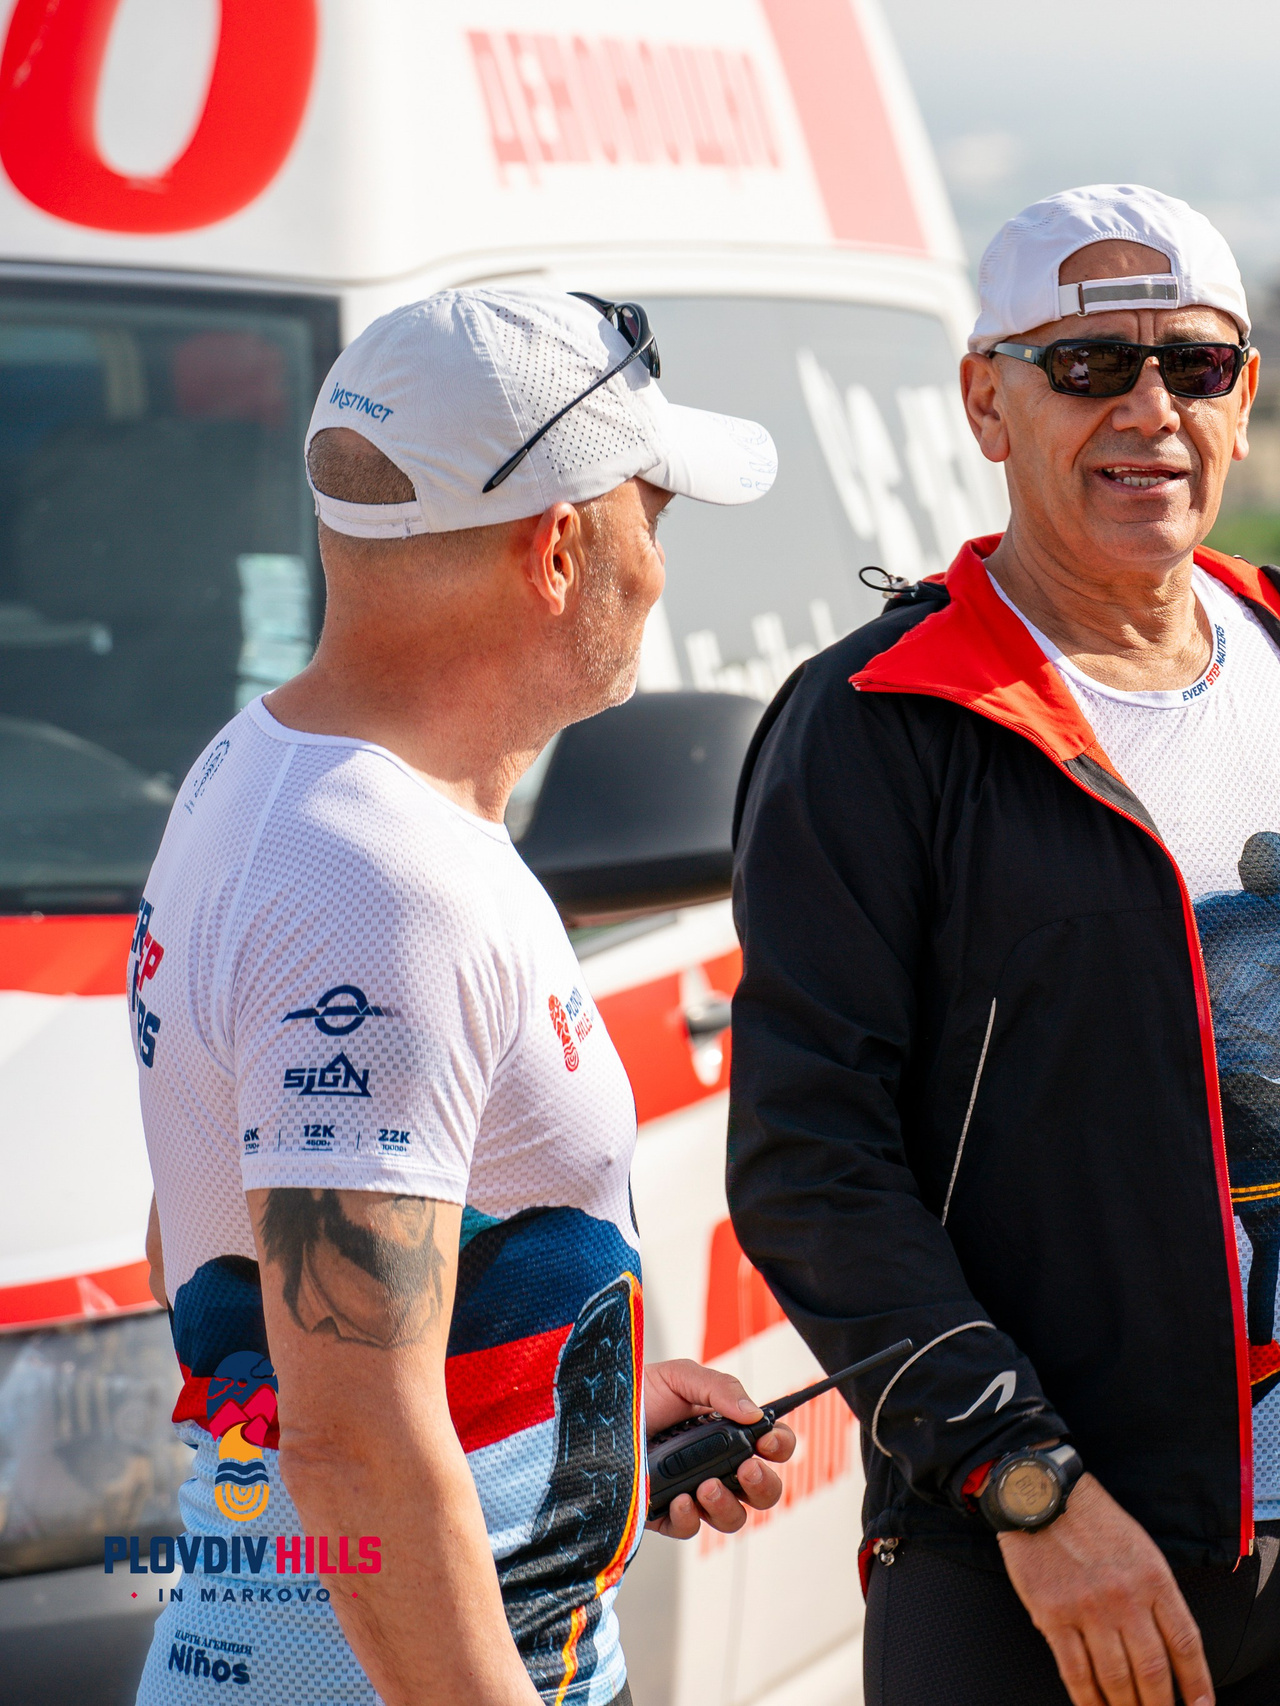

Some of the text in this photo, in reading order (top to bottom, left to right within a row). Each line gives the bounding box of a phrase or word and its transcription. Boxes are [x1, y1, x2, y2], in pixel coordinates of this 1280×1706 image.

[1182, 624, 1227, 701] EVERY STEP MATTERS
[303, 1124, 335, 1139] 12K
[378, 1128, 411, 1144] 22K
